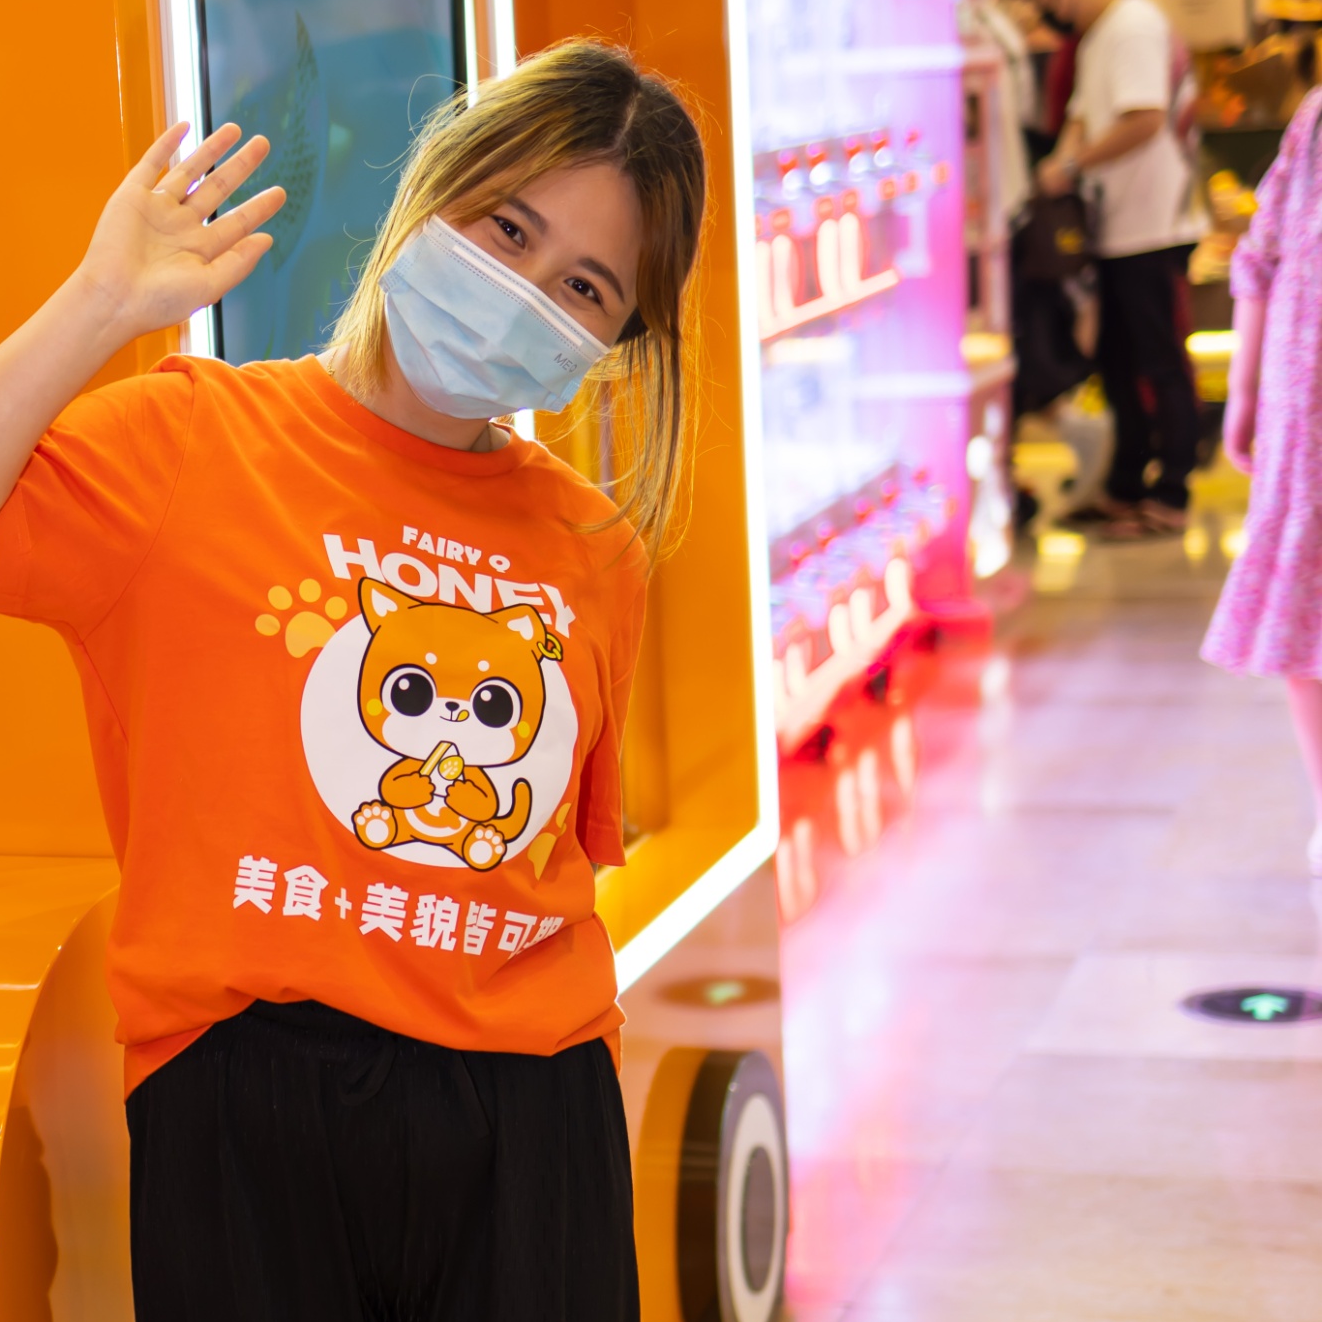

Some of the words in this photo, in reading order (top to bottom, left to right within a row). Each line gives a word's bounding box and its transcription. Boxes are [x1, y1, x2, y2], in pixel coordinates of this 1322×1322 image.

[322, 533, 577, 639] HONEY
[402, 524, 482, 566] FAIRY
[488, 554, 511, 574] Q
